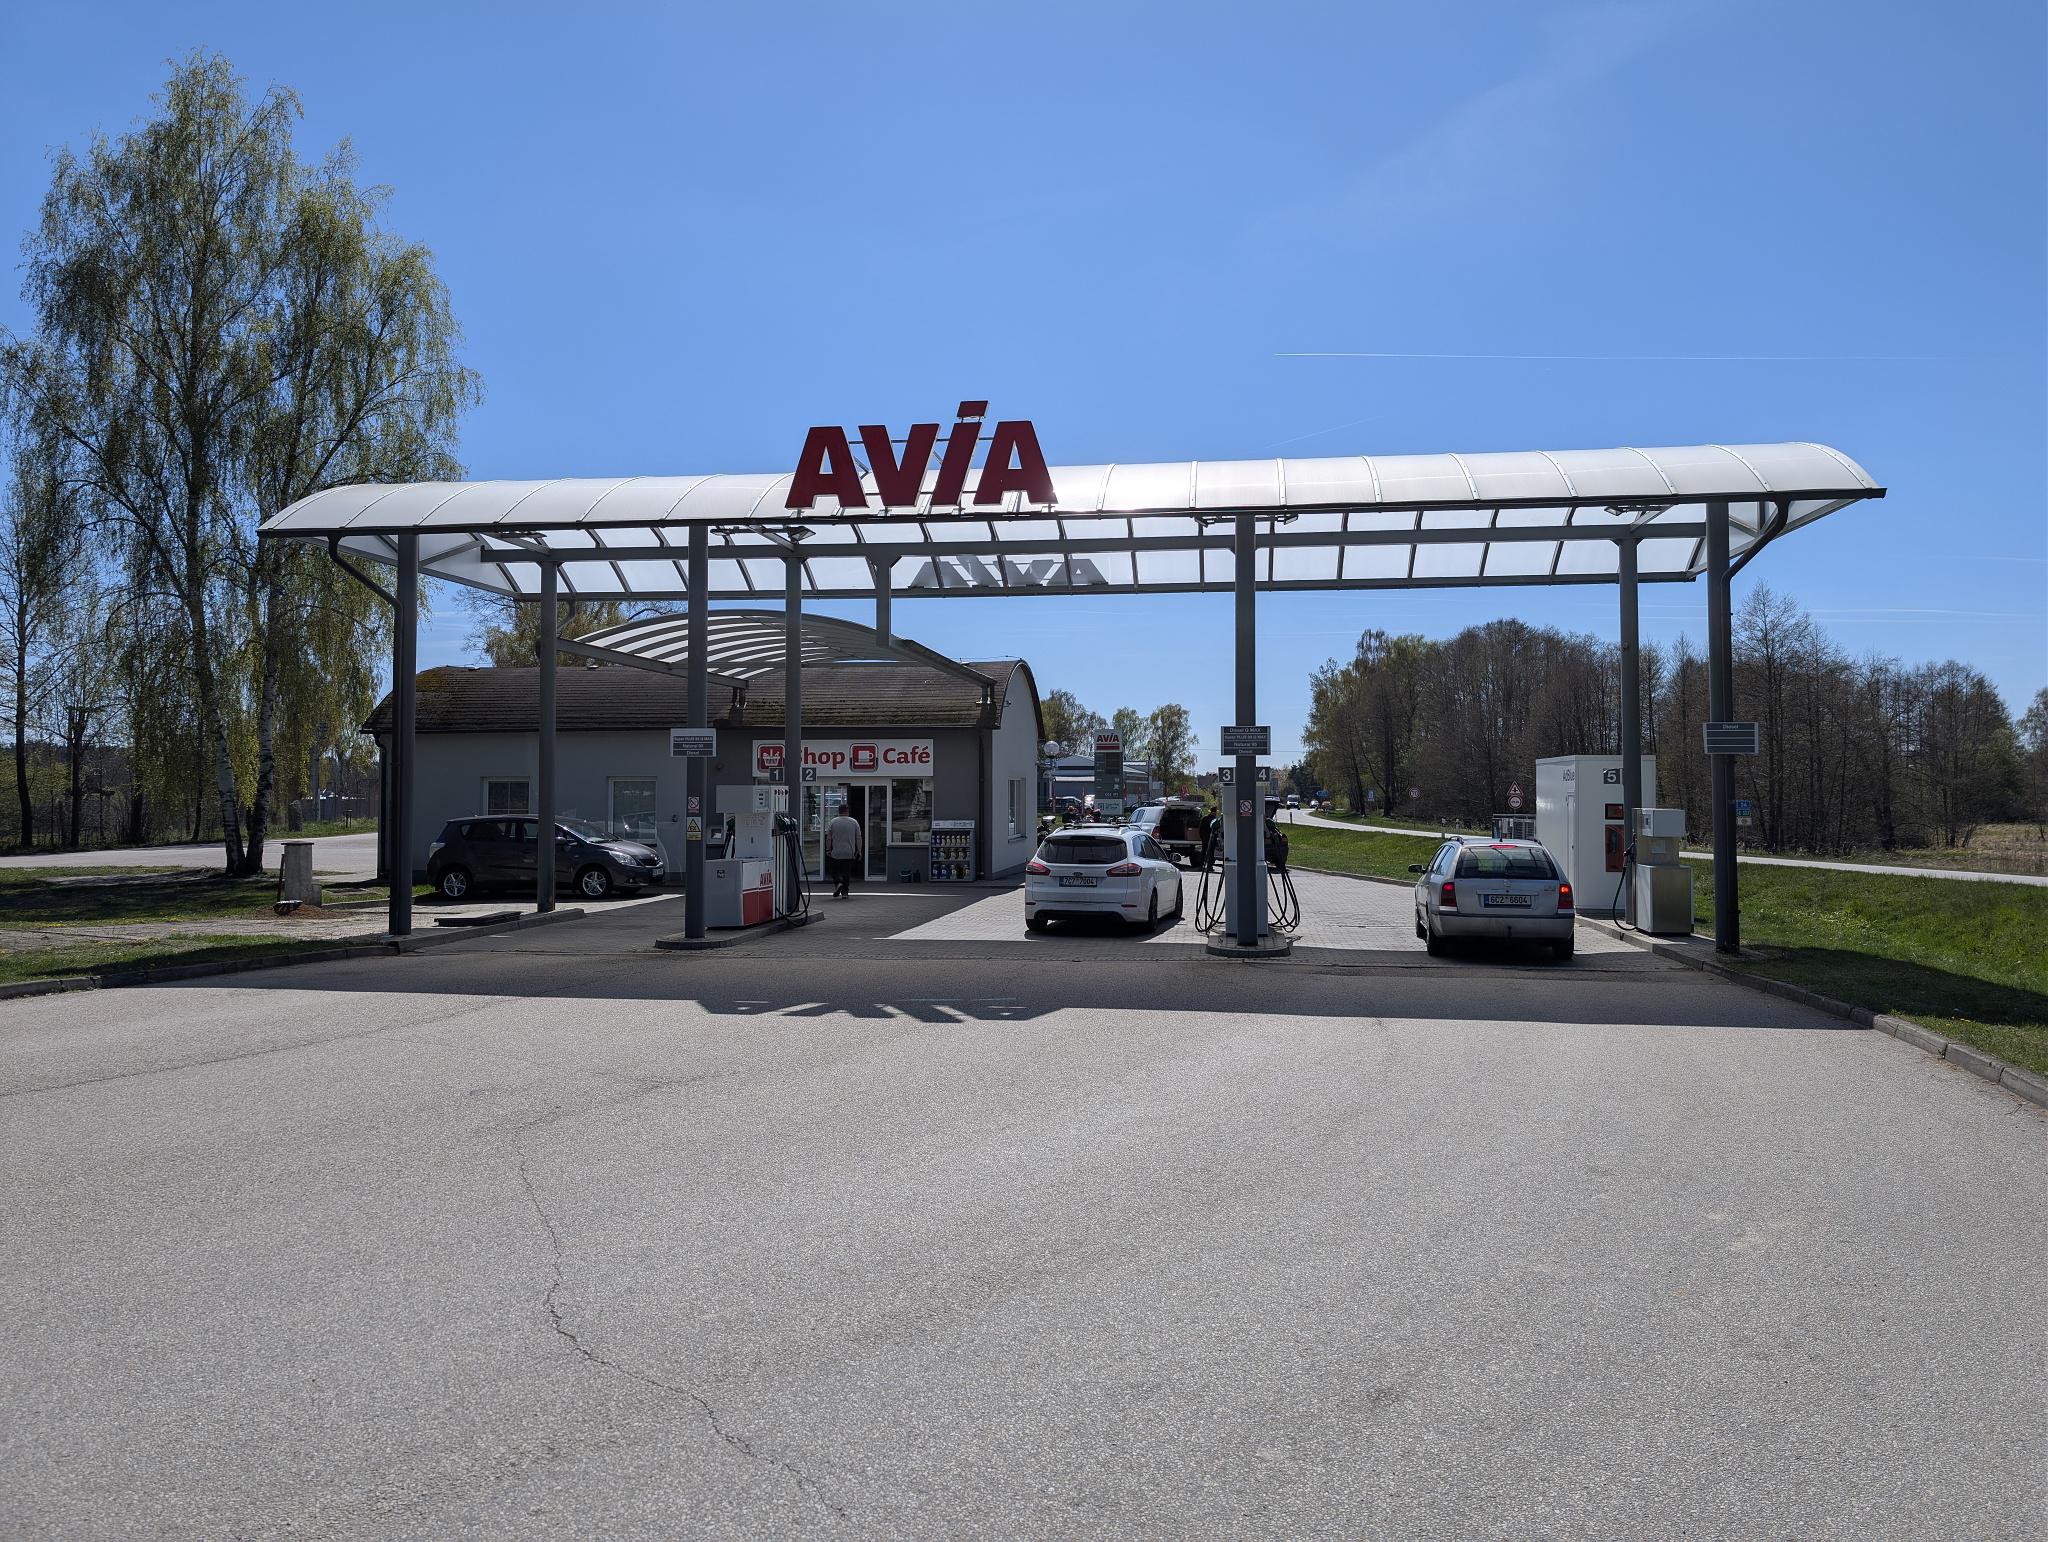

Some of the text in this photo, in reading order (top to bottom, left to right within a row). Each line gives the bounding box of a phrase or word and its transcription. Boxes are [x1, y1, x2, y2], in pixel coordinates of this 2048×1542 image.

[785, 400, 1058, 510] AVIA
[1096, 733, 1120, 743] AVIA
[801, 744, 931, 769] hop Café
[773, 769, 779, 781] 1
[805, 769, 814, 781] 2
[1222, 769, 1231, 781] 3
[1258, 768, 1267, 780] 4
[1607, 770, 1617, 783] 5
